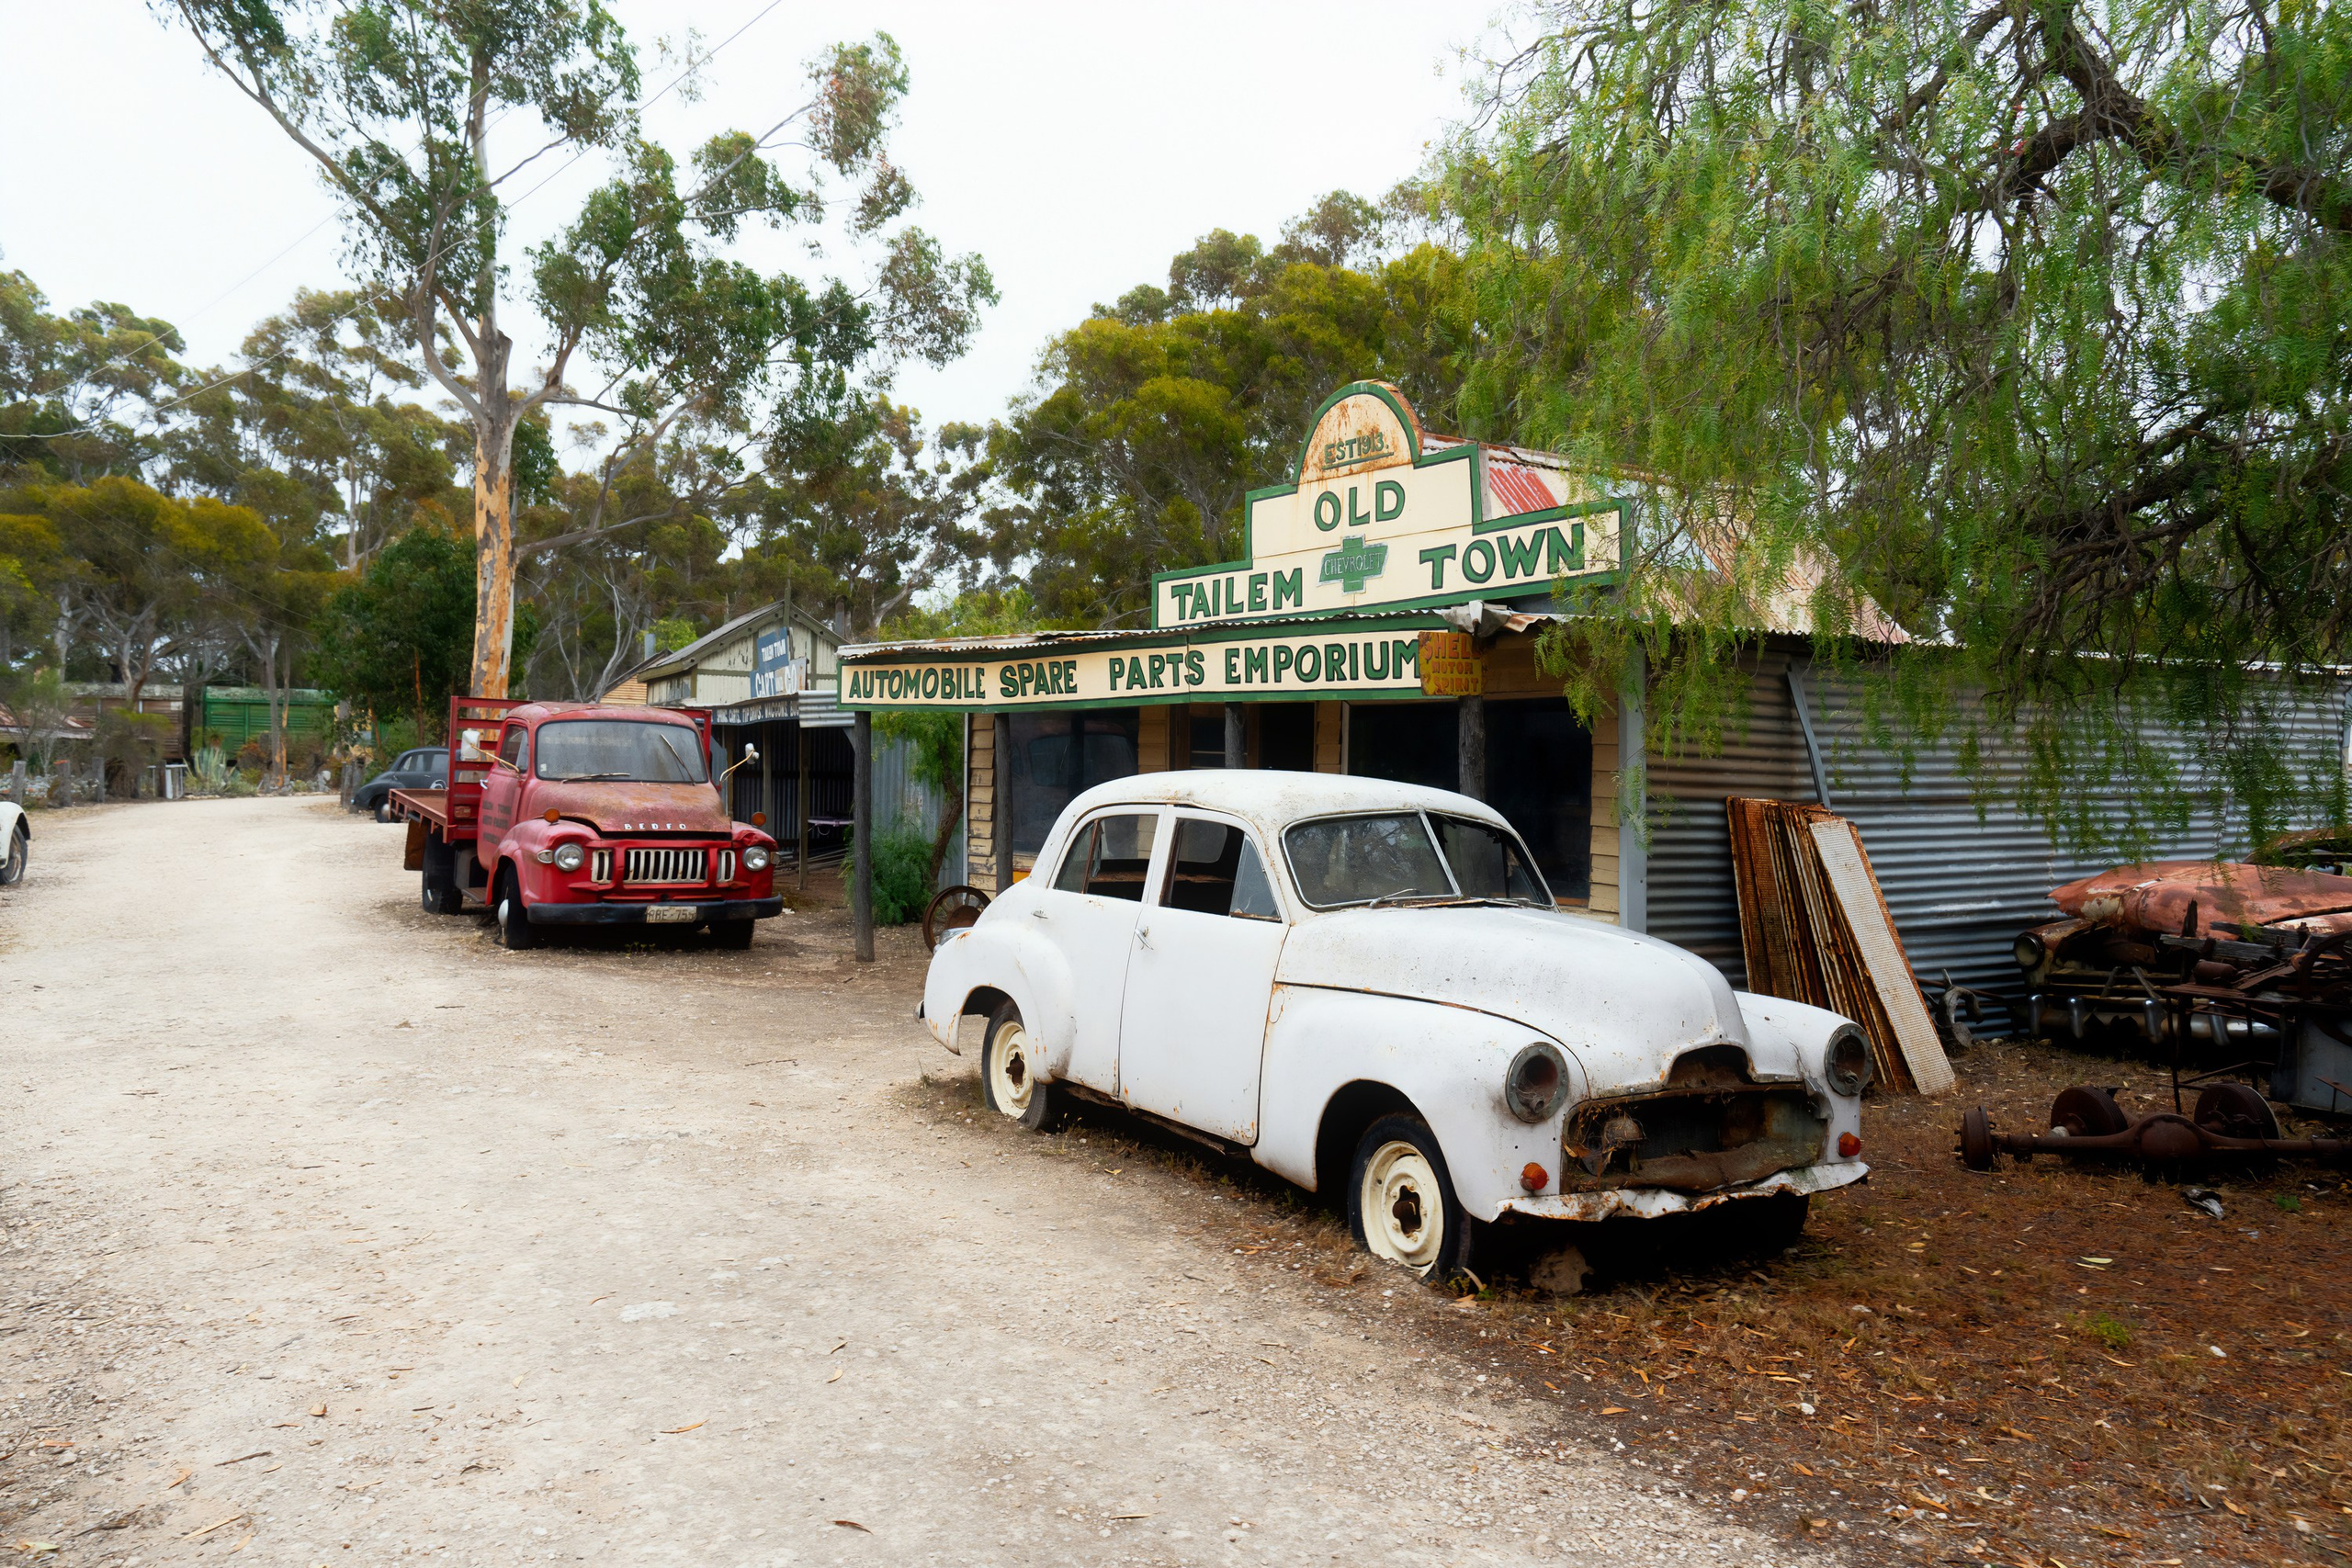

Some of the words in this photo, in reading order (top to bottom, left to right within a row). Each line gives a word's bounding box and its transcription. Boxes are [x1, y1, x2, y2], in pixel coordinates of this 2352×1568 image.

[1314, 479, 1406, 532] OLD
[1171, 566, 1303, 620] TAILEM
[1419, 523, 1585, 590] TOWN
[1324, 552, 1384, 575] CHEVROLET
[1422, 633, 1481, 660] SHELL
[849, 667, 986, 700] AUTOMOBILE
[1000, 660, 1078, 698] SPARE
[1109, 650, 1204, 691] PARTS
[1225, 638, 1420, 684] EMPORIUM
[1431, 661, 1474, 674] MOTOR
